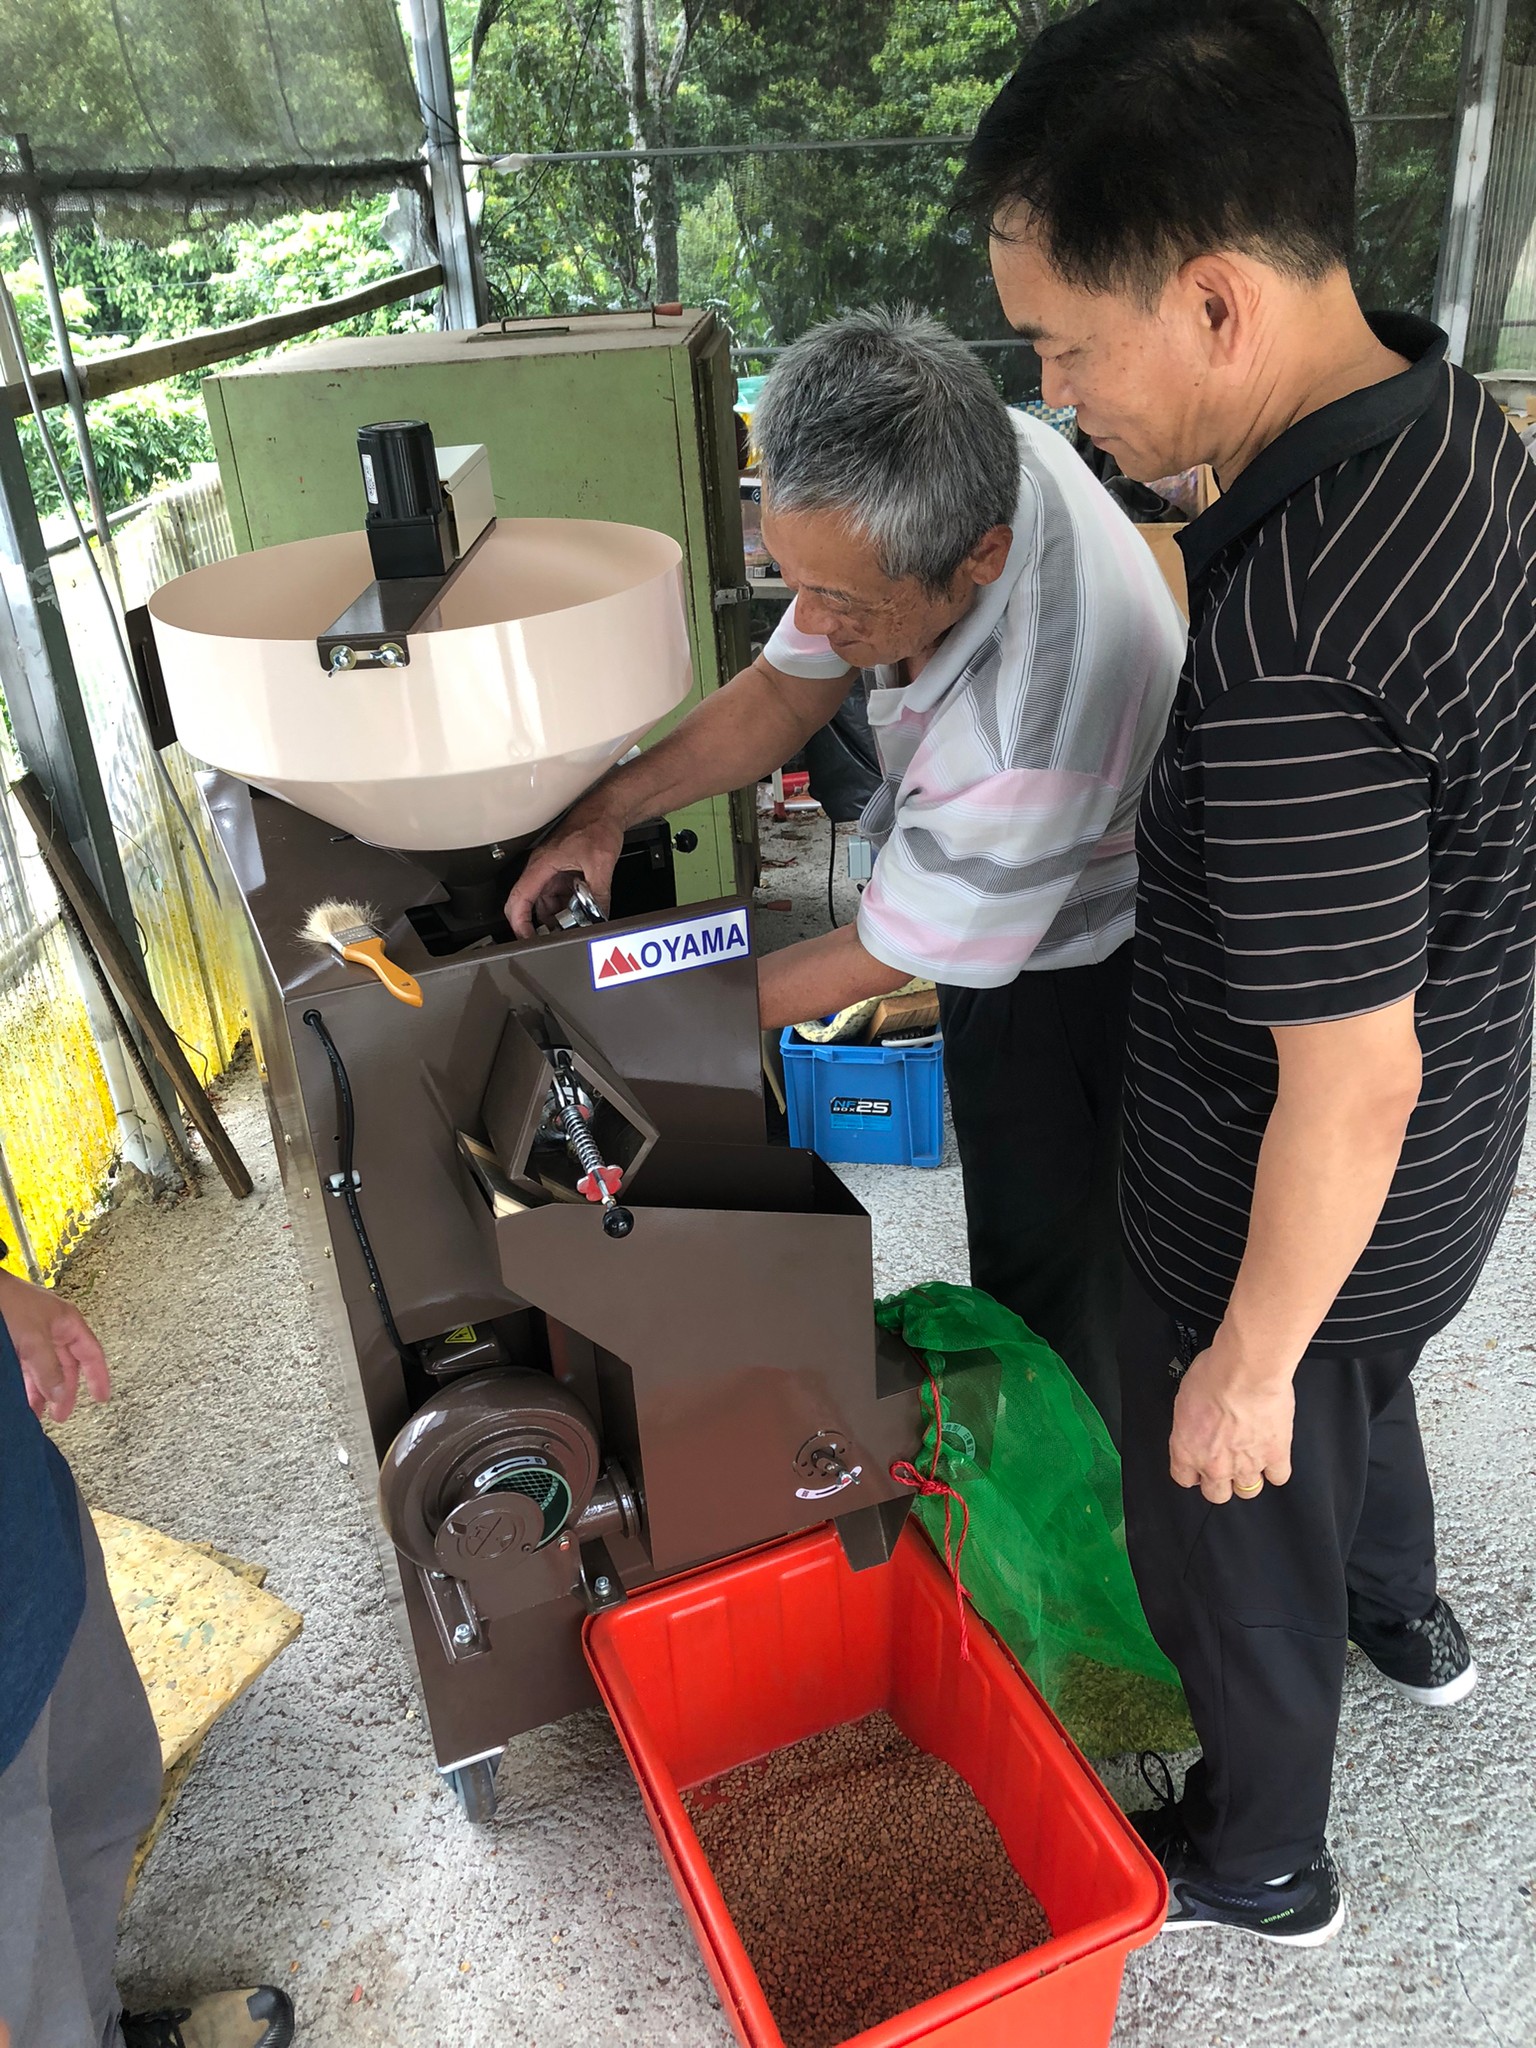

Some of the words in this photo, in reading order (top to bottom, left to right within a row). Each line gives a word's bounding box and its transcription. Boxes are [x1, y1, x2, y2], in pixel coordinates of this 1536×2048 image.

[641, 923, 745, 968] OYAMA
[834, 1100, 857, 1108] NF
[856, 1101, 889, 1114] 25
